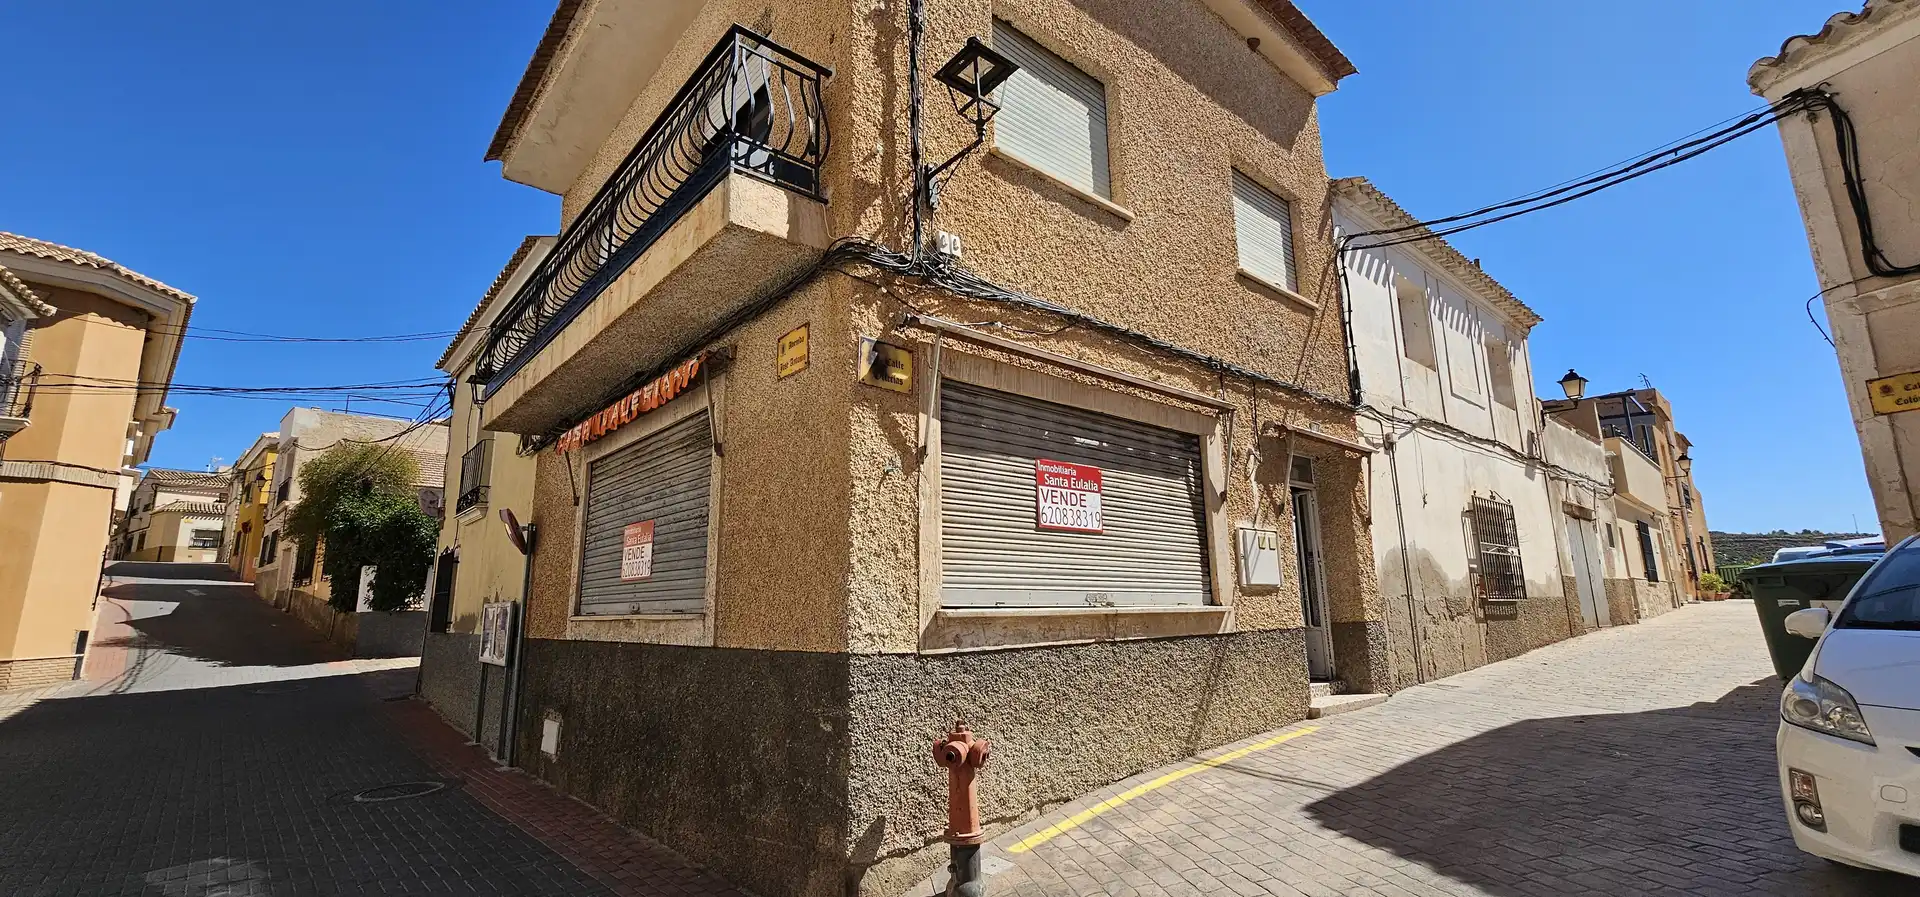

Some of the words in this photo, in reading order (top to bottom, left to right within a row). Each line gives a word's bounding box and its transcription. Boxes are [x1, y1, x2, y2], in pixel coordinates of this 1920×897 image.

[887, 358, 904, 370] Calle
[1037, 460, 1077, 476] Inmobiliaria
[1044, 473, 1068, 488] Santa
[1070, 477, 1099, 492] Eulalia
[1040, 488, 1087, 508] VENDE
[1041, 505, 1101, 529] 620838319
[623, 545, 645, 561] VENDE
